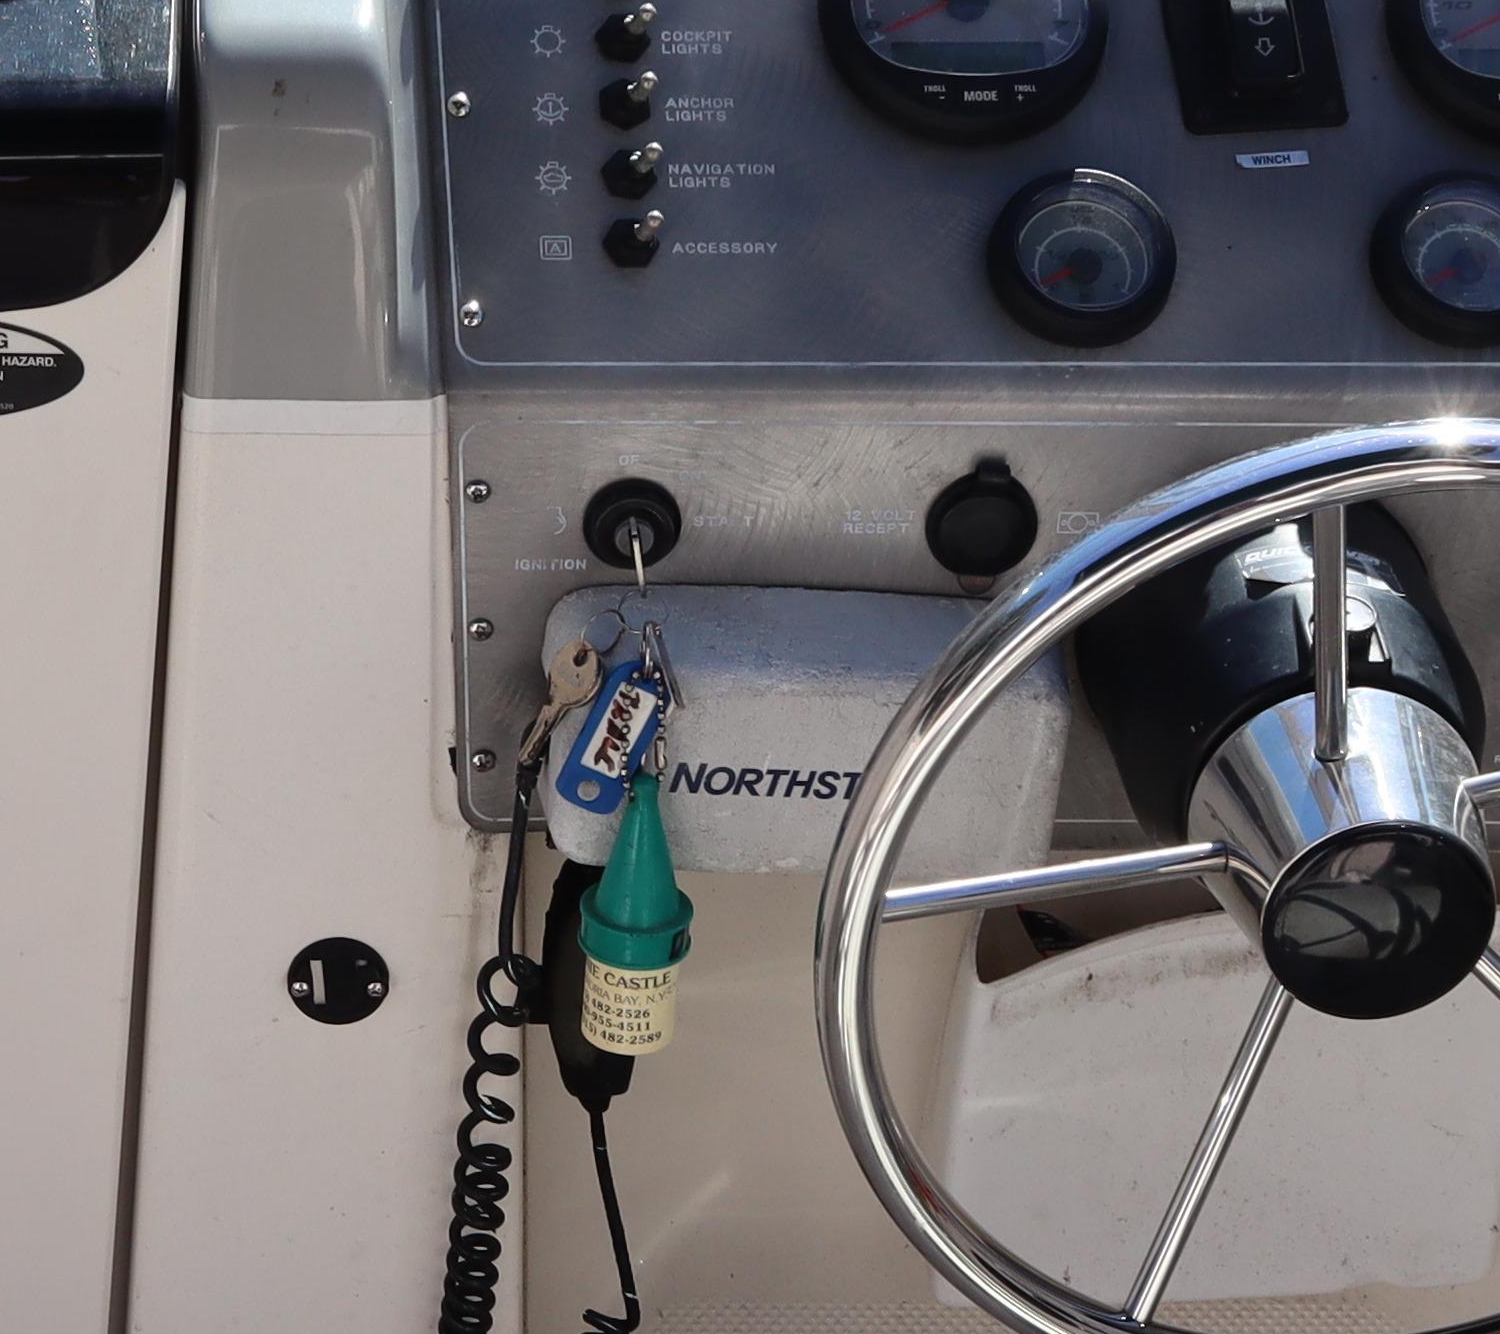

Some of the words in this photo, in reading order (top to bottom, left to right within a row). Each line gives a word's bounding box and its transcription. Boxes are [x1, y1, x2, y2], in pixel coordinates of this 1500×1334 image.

[660, 31, 733, 42] COCKPIT
[661, 43, 723, 55] LIGHTS
[963, 90, 999, 102] MODE
[665, 97, 735, 108] ANCHOR
[665, 110, 727, 122] LIGHTS
[1251, 153, 1292, 165] WINCH
[668, 163, 776, 176] NAVIGATION
[669, 177, 731, 189] LIGHTS
[671, 242, 779, 254] ACCESSORY
[2, 356, 57, 367] HAZARD.
[694, 515, 755, 528] STAT
[844, 509, 862, 521] 12
[870, 509, 918, 522] VOLT
[843, 522, 911, 535] RECEPT
[604, 970, 672, 990] CASTLE
[600, 1030, 662, 1045] 482-2589
